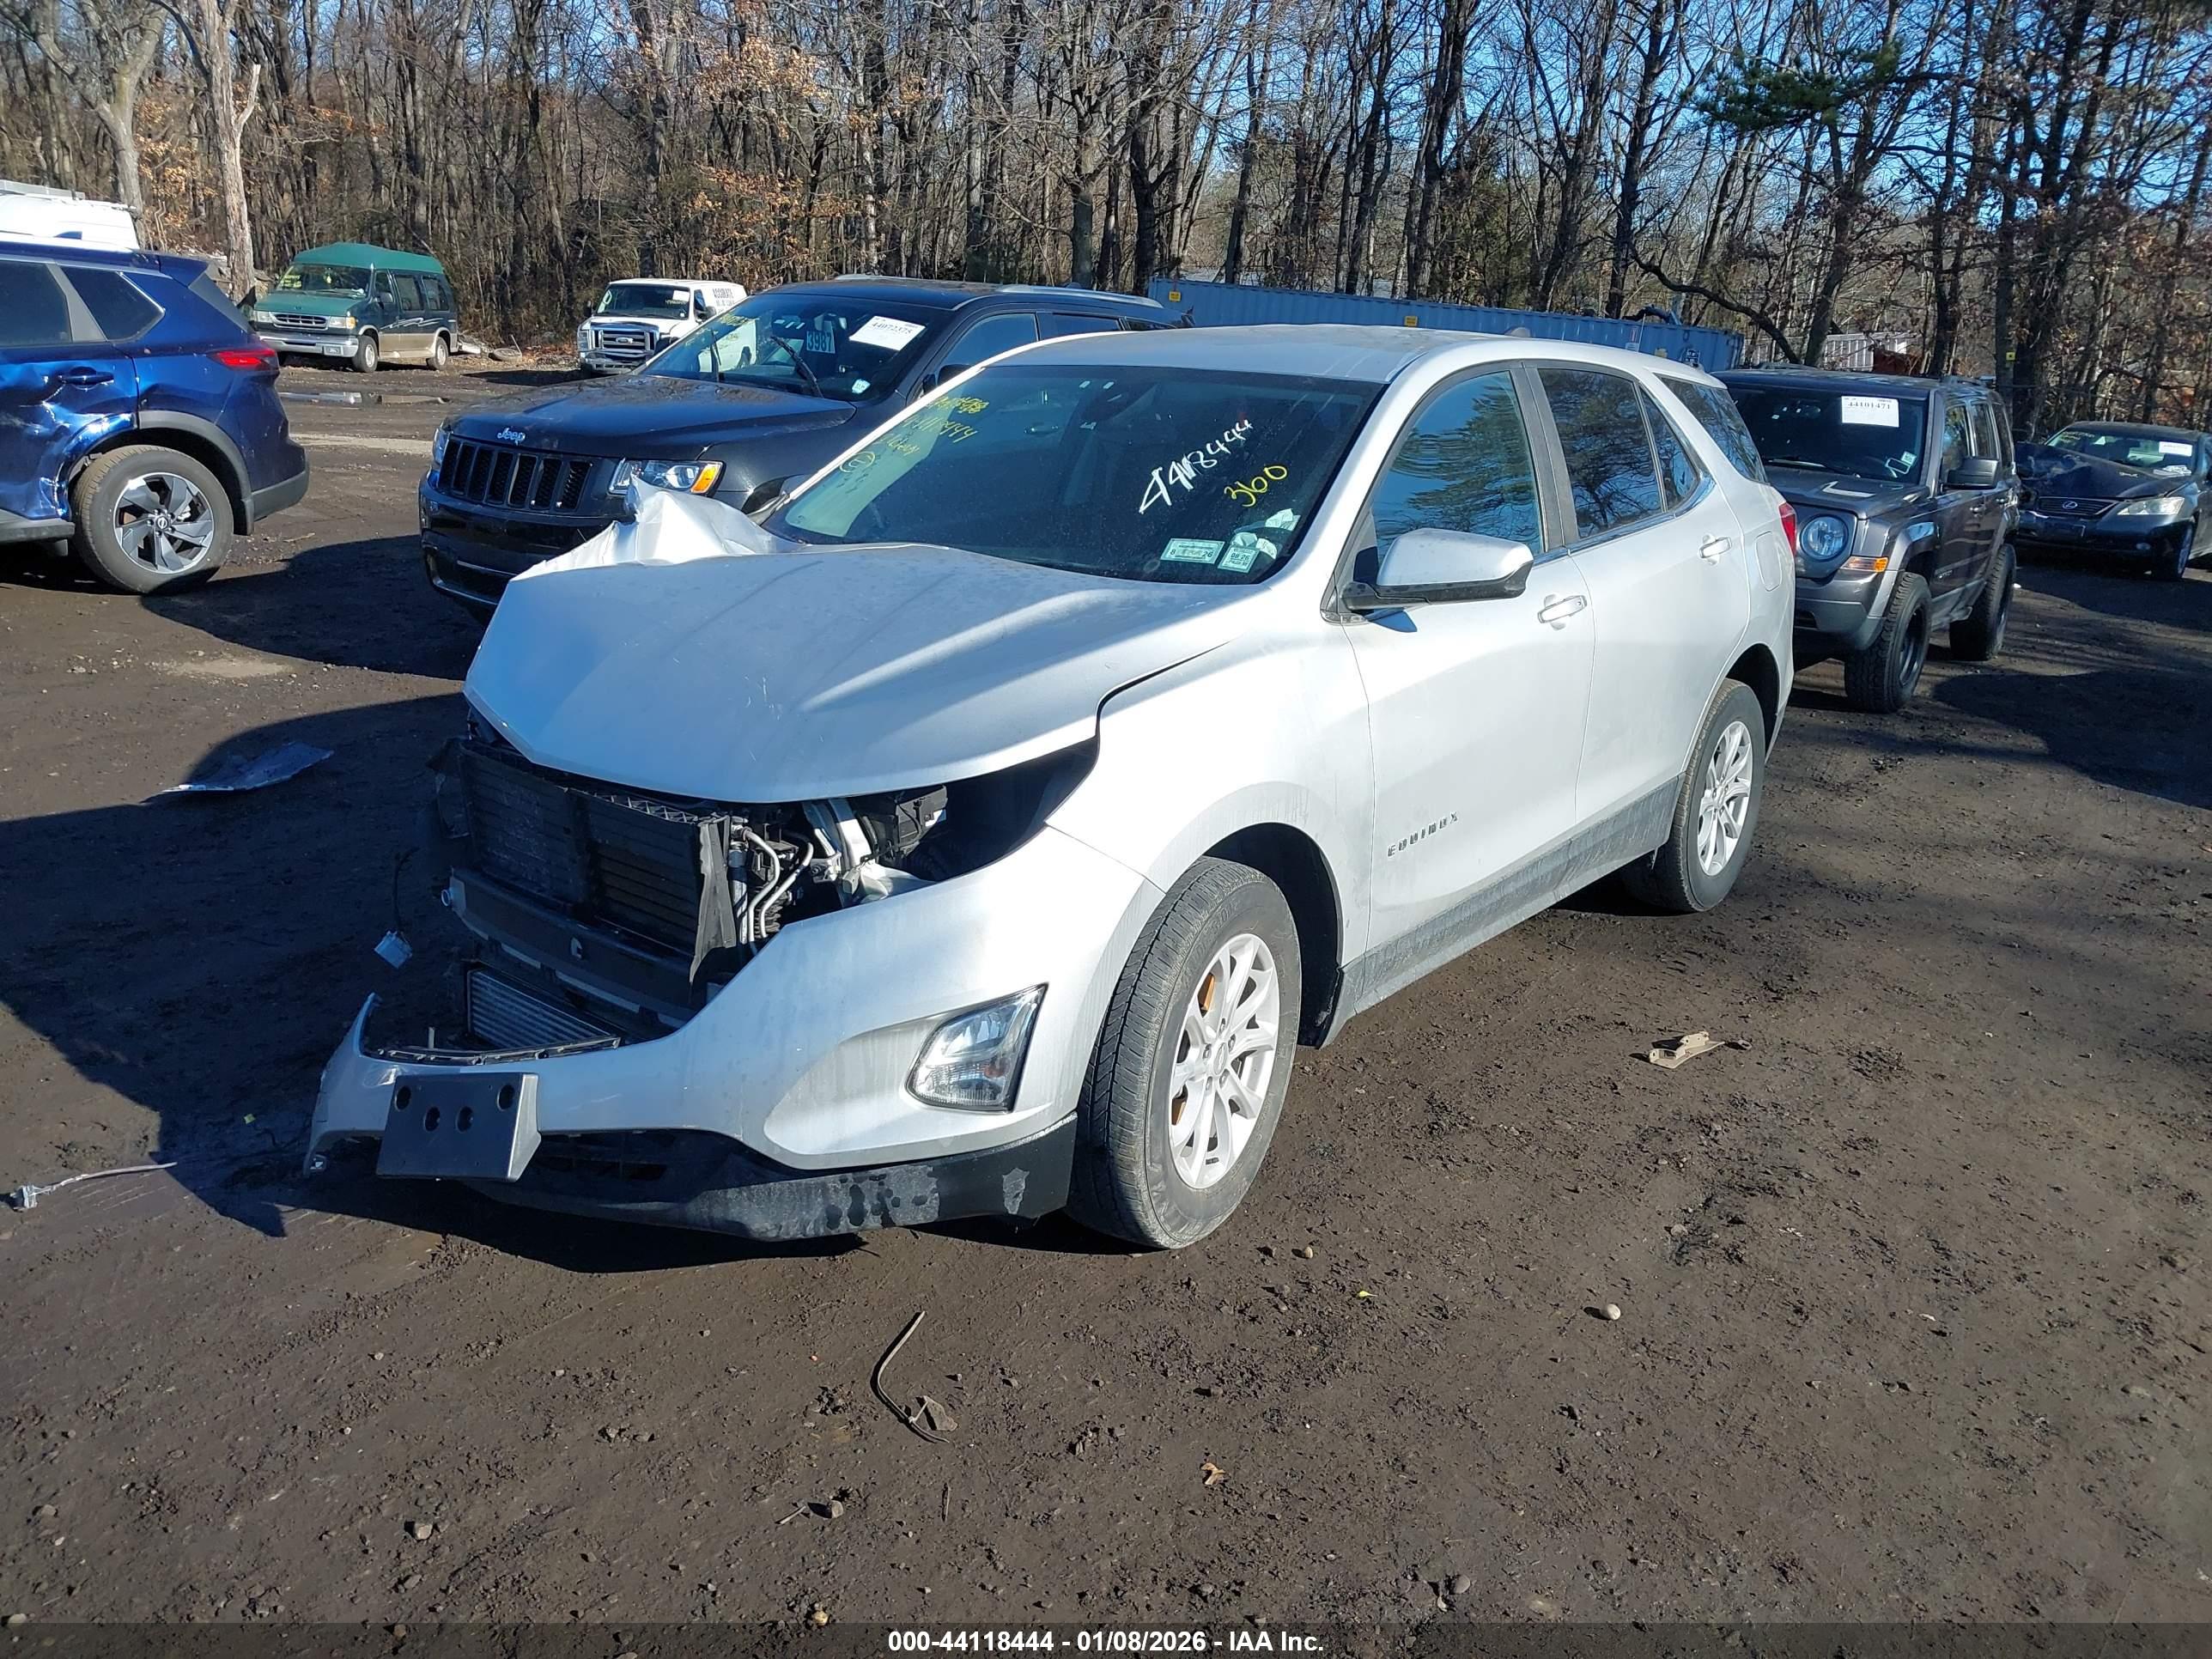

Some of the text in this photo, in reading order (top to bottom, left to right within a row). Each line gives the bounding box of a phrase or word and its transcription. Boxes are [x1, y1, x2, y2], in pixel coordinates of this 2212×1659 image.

[806, 330, 832, 352] 3987
[497, 428, 526, 446] Jeep
[1224, 465, 1288, 507] 360
[1387, 811, 1458, 857] EQUINOX
